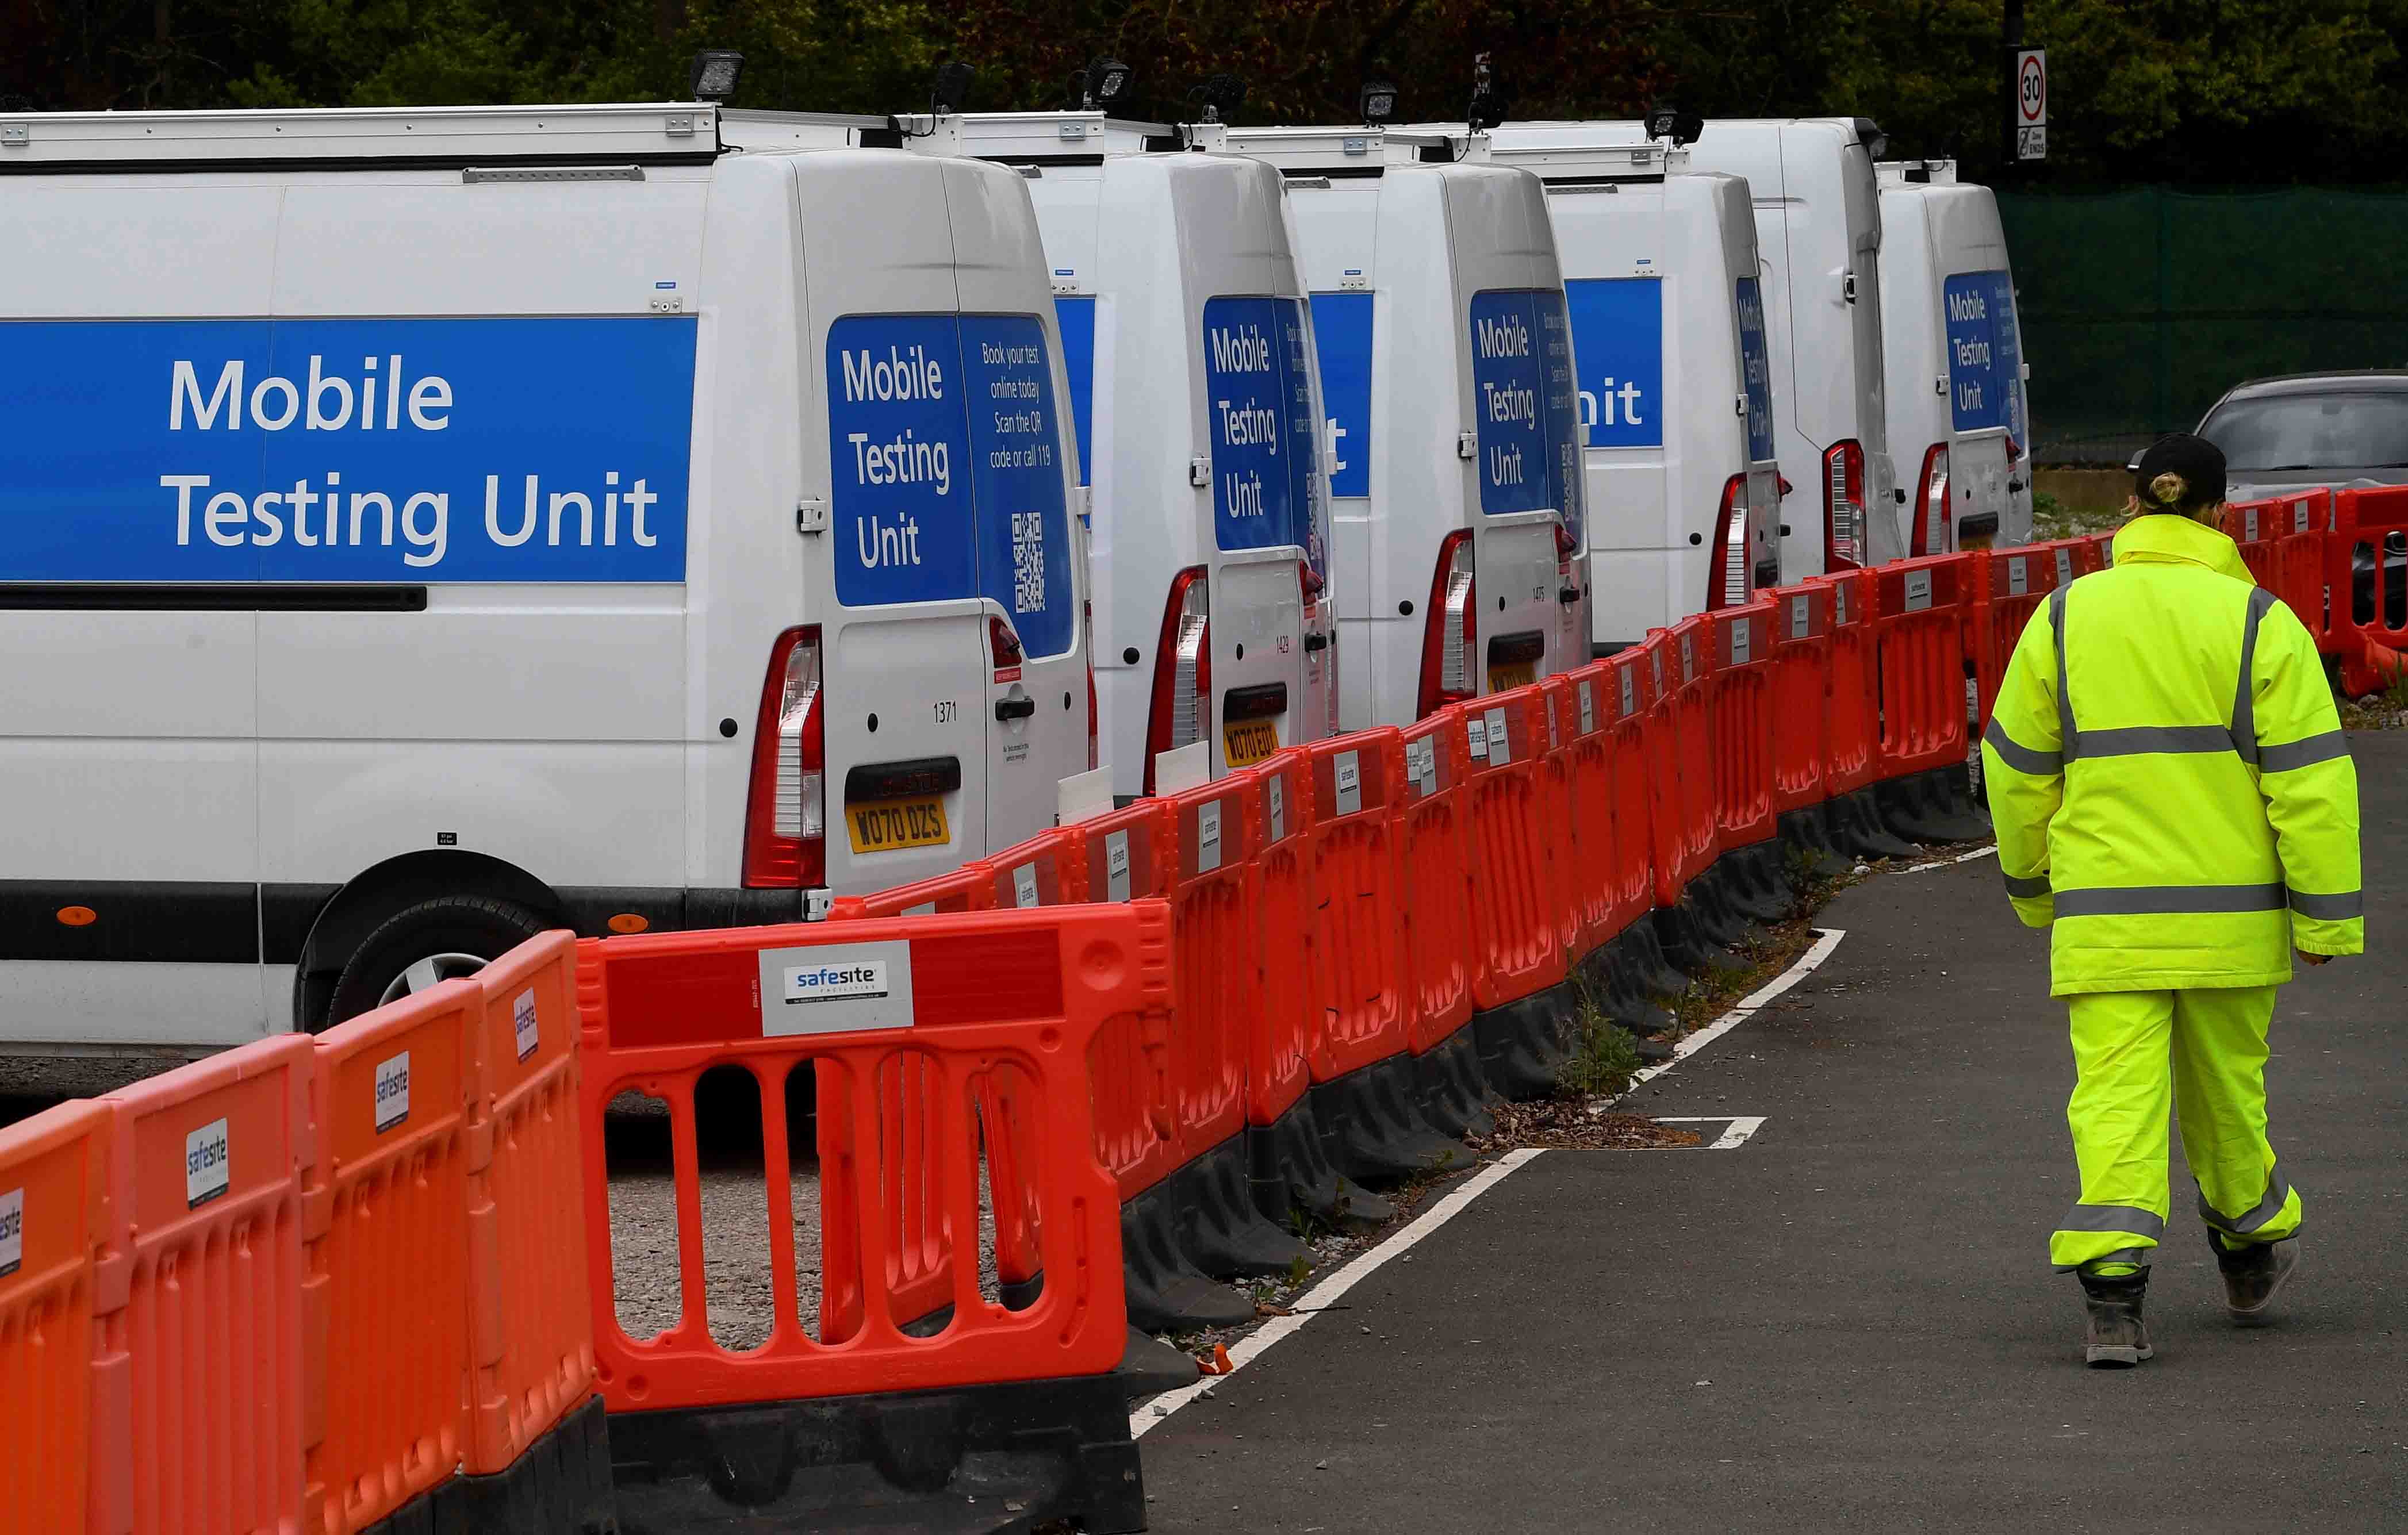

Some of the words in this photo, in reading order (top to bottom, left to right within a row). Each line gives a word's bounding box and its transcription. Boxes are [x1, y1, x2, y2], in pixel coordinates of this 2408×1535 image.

[2023, 74, 2041, 101] 30
[1949, 289, 1986, 322] Mobile
[981, 341, 1006, 364] Book
[1006, 346, 1024, 370] your
[1025, 345, 1040, 364] test
[1211, 324, 1270, 373] Mobile
[1478, 313, 1529, 358] Mobile
[1954, 336, 1991, 371] Testing
[170, 355, 454, 431] Mobile
[841, 345, 943, 402] Mobile
[990, 375, 1017, 399] online
[1018, 375, 1040, 404] today
[1483, 379, 1536, 431] Testing
[1579, 377, 1643, 425] nit
[1959, 380, 1983, 412] Unit
[995, 410, 1015, 433] Scan
[1015, 409, 1030, 432] the
[1030, 410, 1042, 436] QR
[1218, 397, 1276, 455] Testing
[848, 429, 950, 495] Testing
[990, 445, 1011, 469] code
[1013, 451, 1022, 467] or
[1023, 443, 1037, 467] call
[1038, 444, 1051, 466] 119
[1490, 443, 1523, 486] Unit
[1226, 470, 1263, 519] Unit
[160, 472, 450, 567] Testing
[484, 472, 658, 547] Unit
[857, 512, 921, 569] Unit
[934, 700, 957, 723] 1371
[906, 803, 942, 840] DZS
[797, 967, 875, 987] safesite
[377, 1067, 408, 1103] safesite
[188, 1135, 226, 1175] safesite
